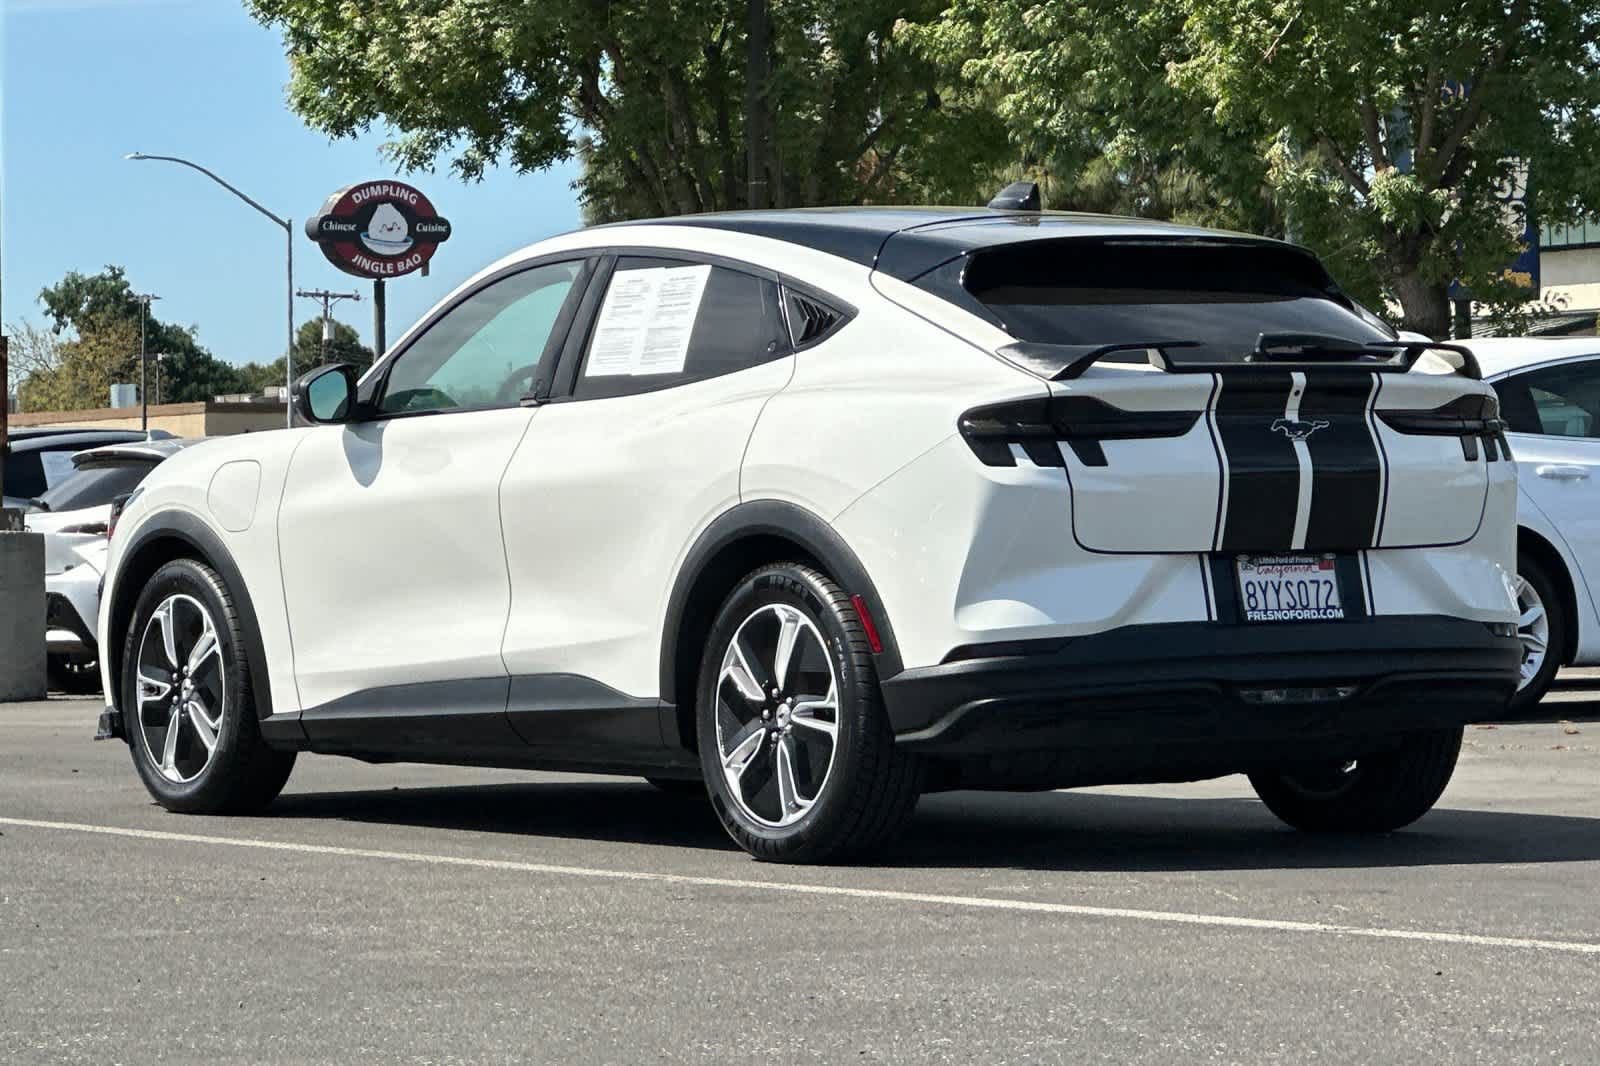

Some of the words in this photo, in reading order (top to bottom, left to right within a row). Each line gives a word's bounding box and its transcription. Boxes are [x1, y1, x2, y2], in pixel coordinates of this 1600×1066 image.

[352, 185, 418, 204] DUMPLING
[322, 221, 357, 231] Chinese
[415, 223, 448, 232] Cuisine
[352, 254, 394, 274] JINGLE
[397, 254, 422, 272] BAO
[1257, 564, 1313, 578] California
[1245, 580, 1337, 609] 8YYS072
[1247, 609, 1344, 620] FRESNOFORD.COM
